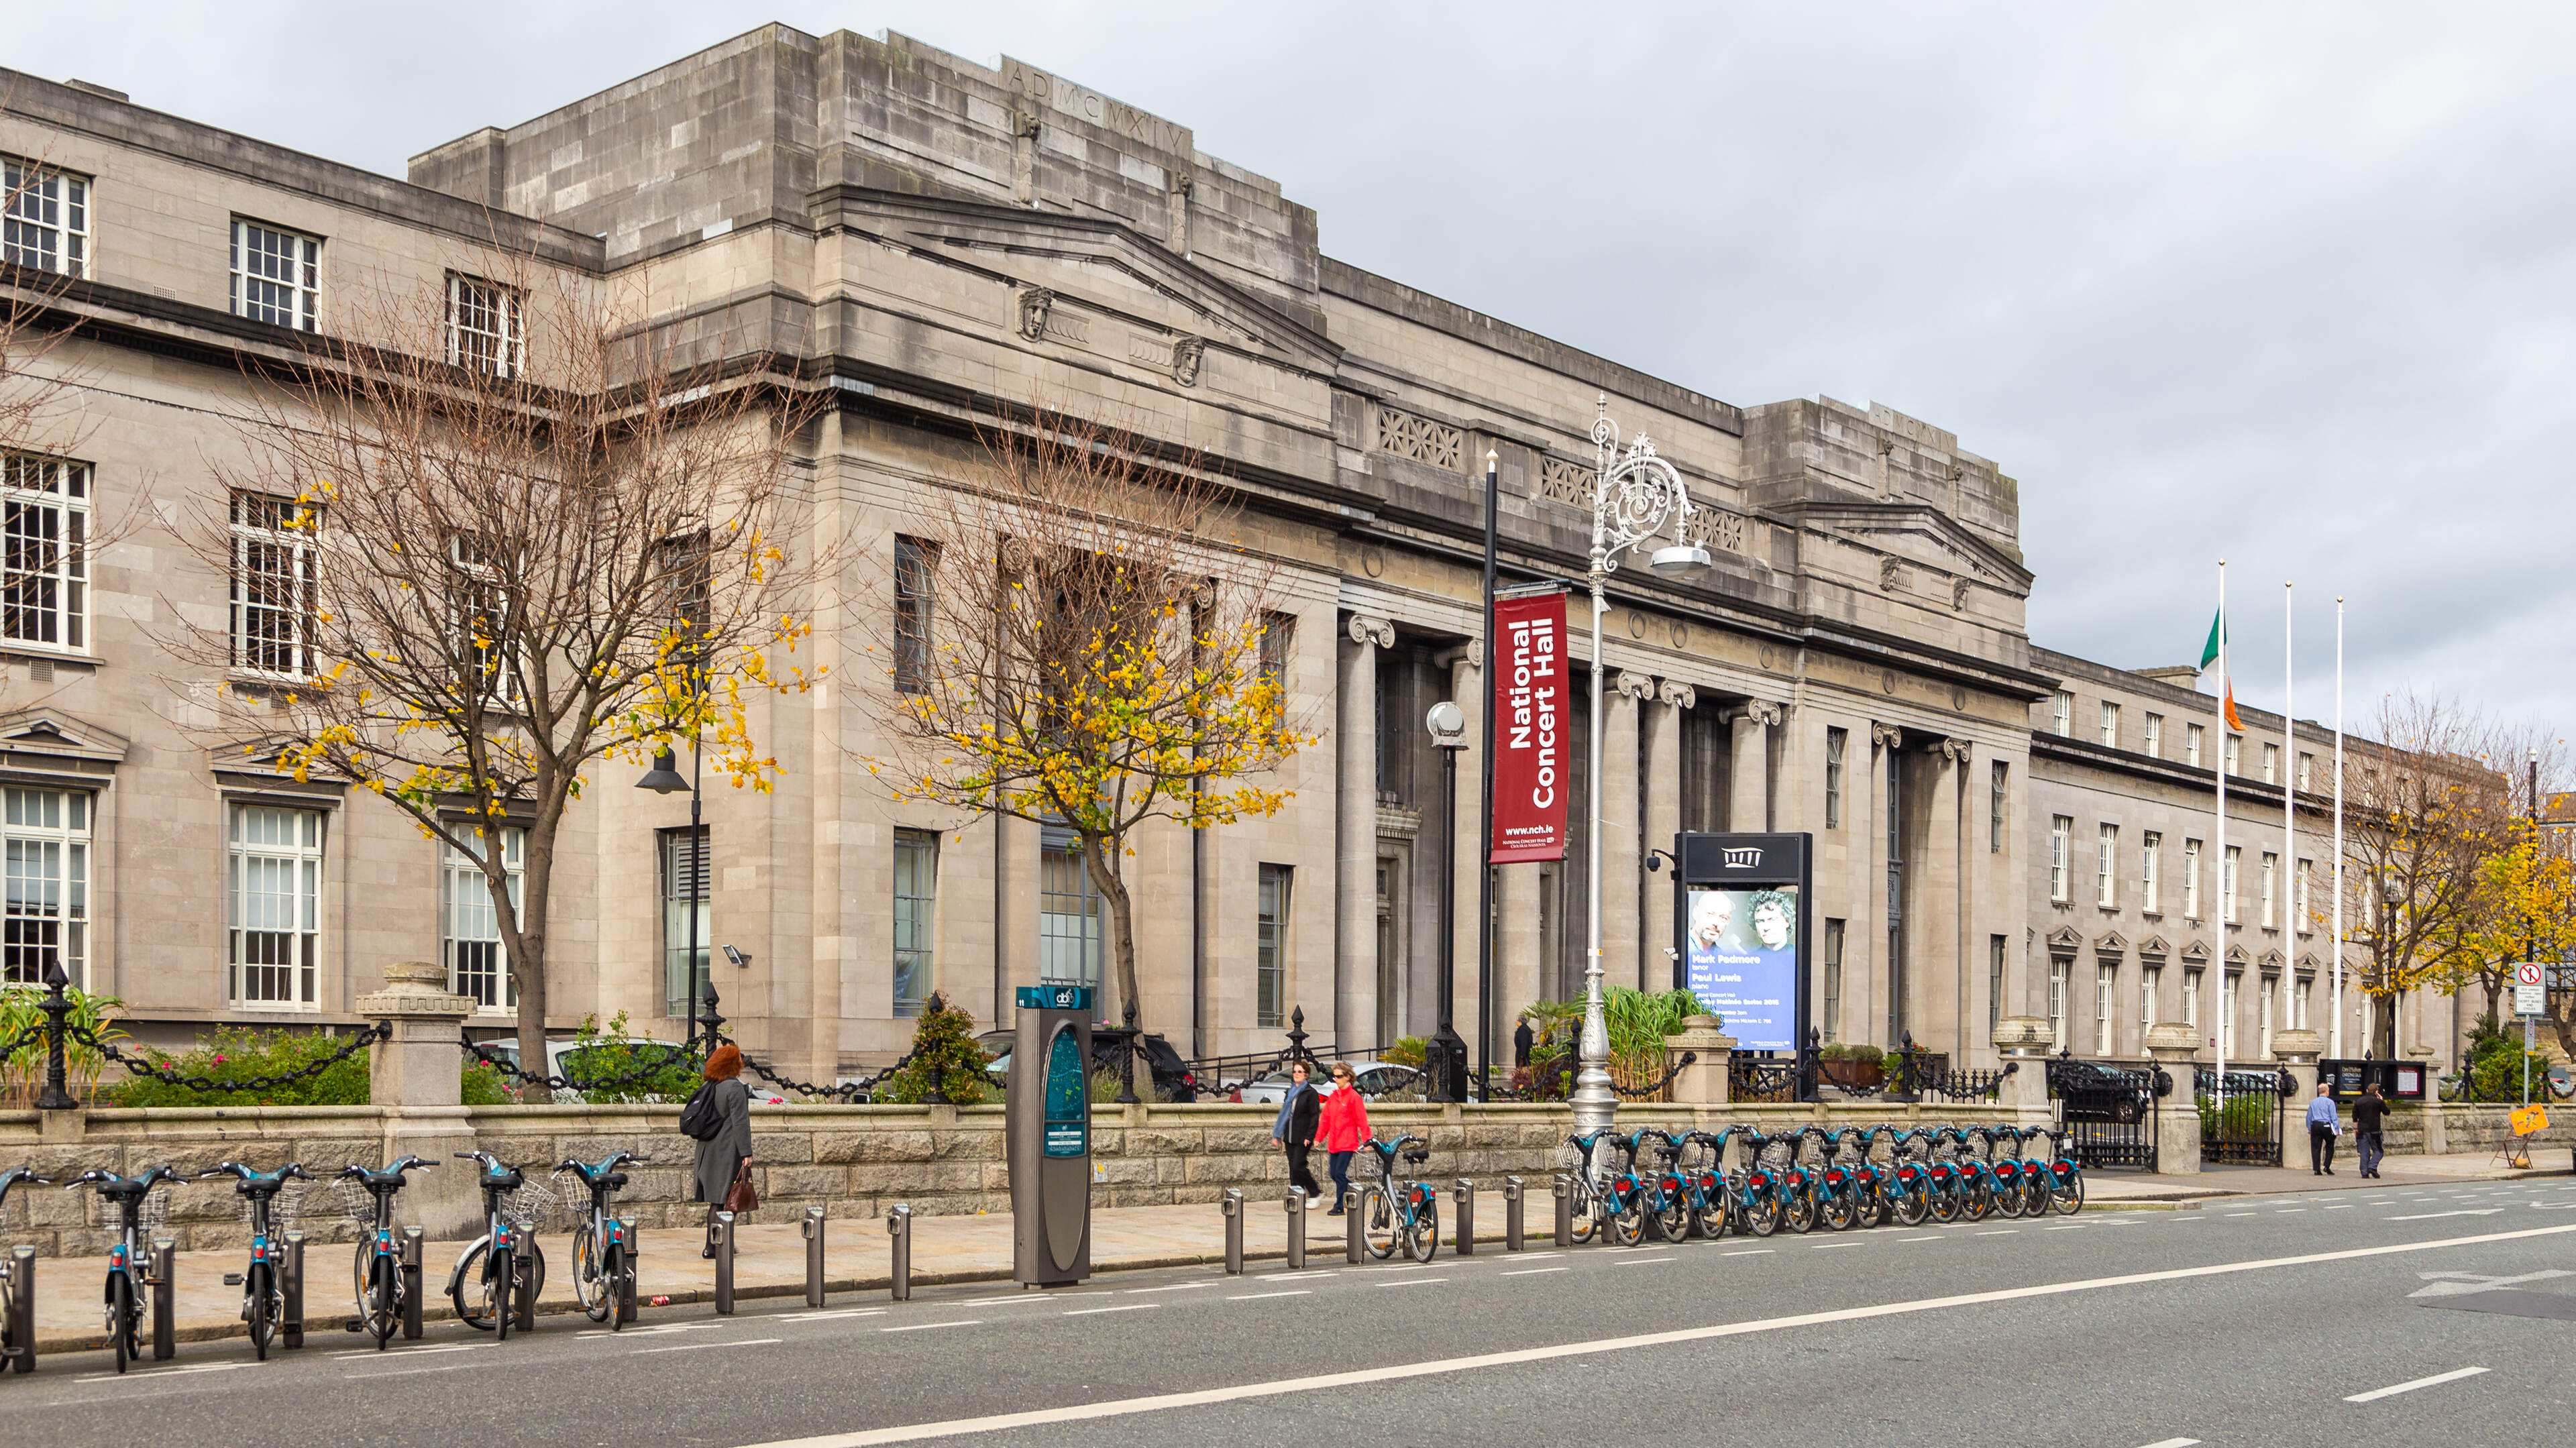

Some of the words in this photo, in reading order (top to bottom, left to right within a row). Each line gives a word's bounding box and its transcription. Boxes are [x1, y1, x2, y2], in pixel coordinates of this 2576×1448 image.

[1532, 618, 1555, 677] Hall
[1508, 620, 1532, 749] National
[1533, 686, 1556, 809] Concert
[1505, 824, 1554, 836] www.nch.ie
[1692, 954, 1715, 964] Mark
[1718, 954, 1761, 964] Padmore
[1692, 973, 1712, 982] Paul
